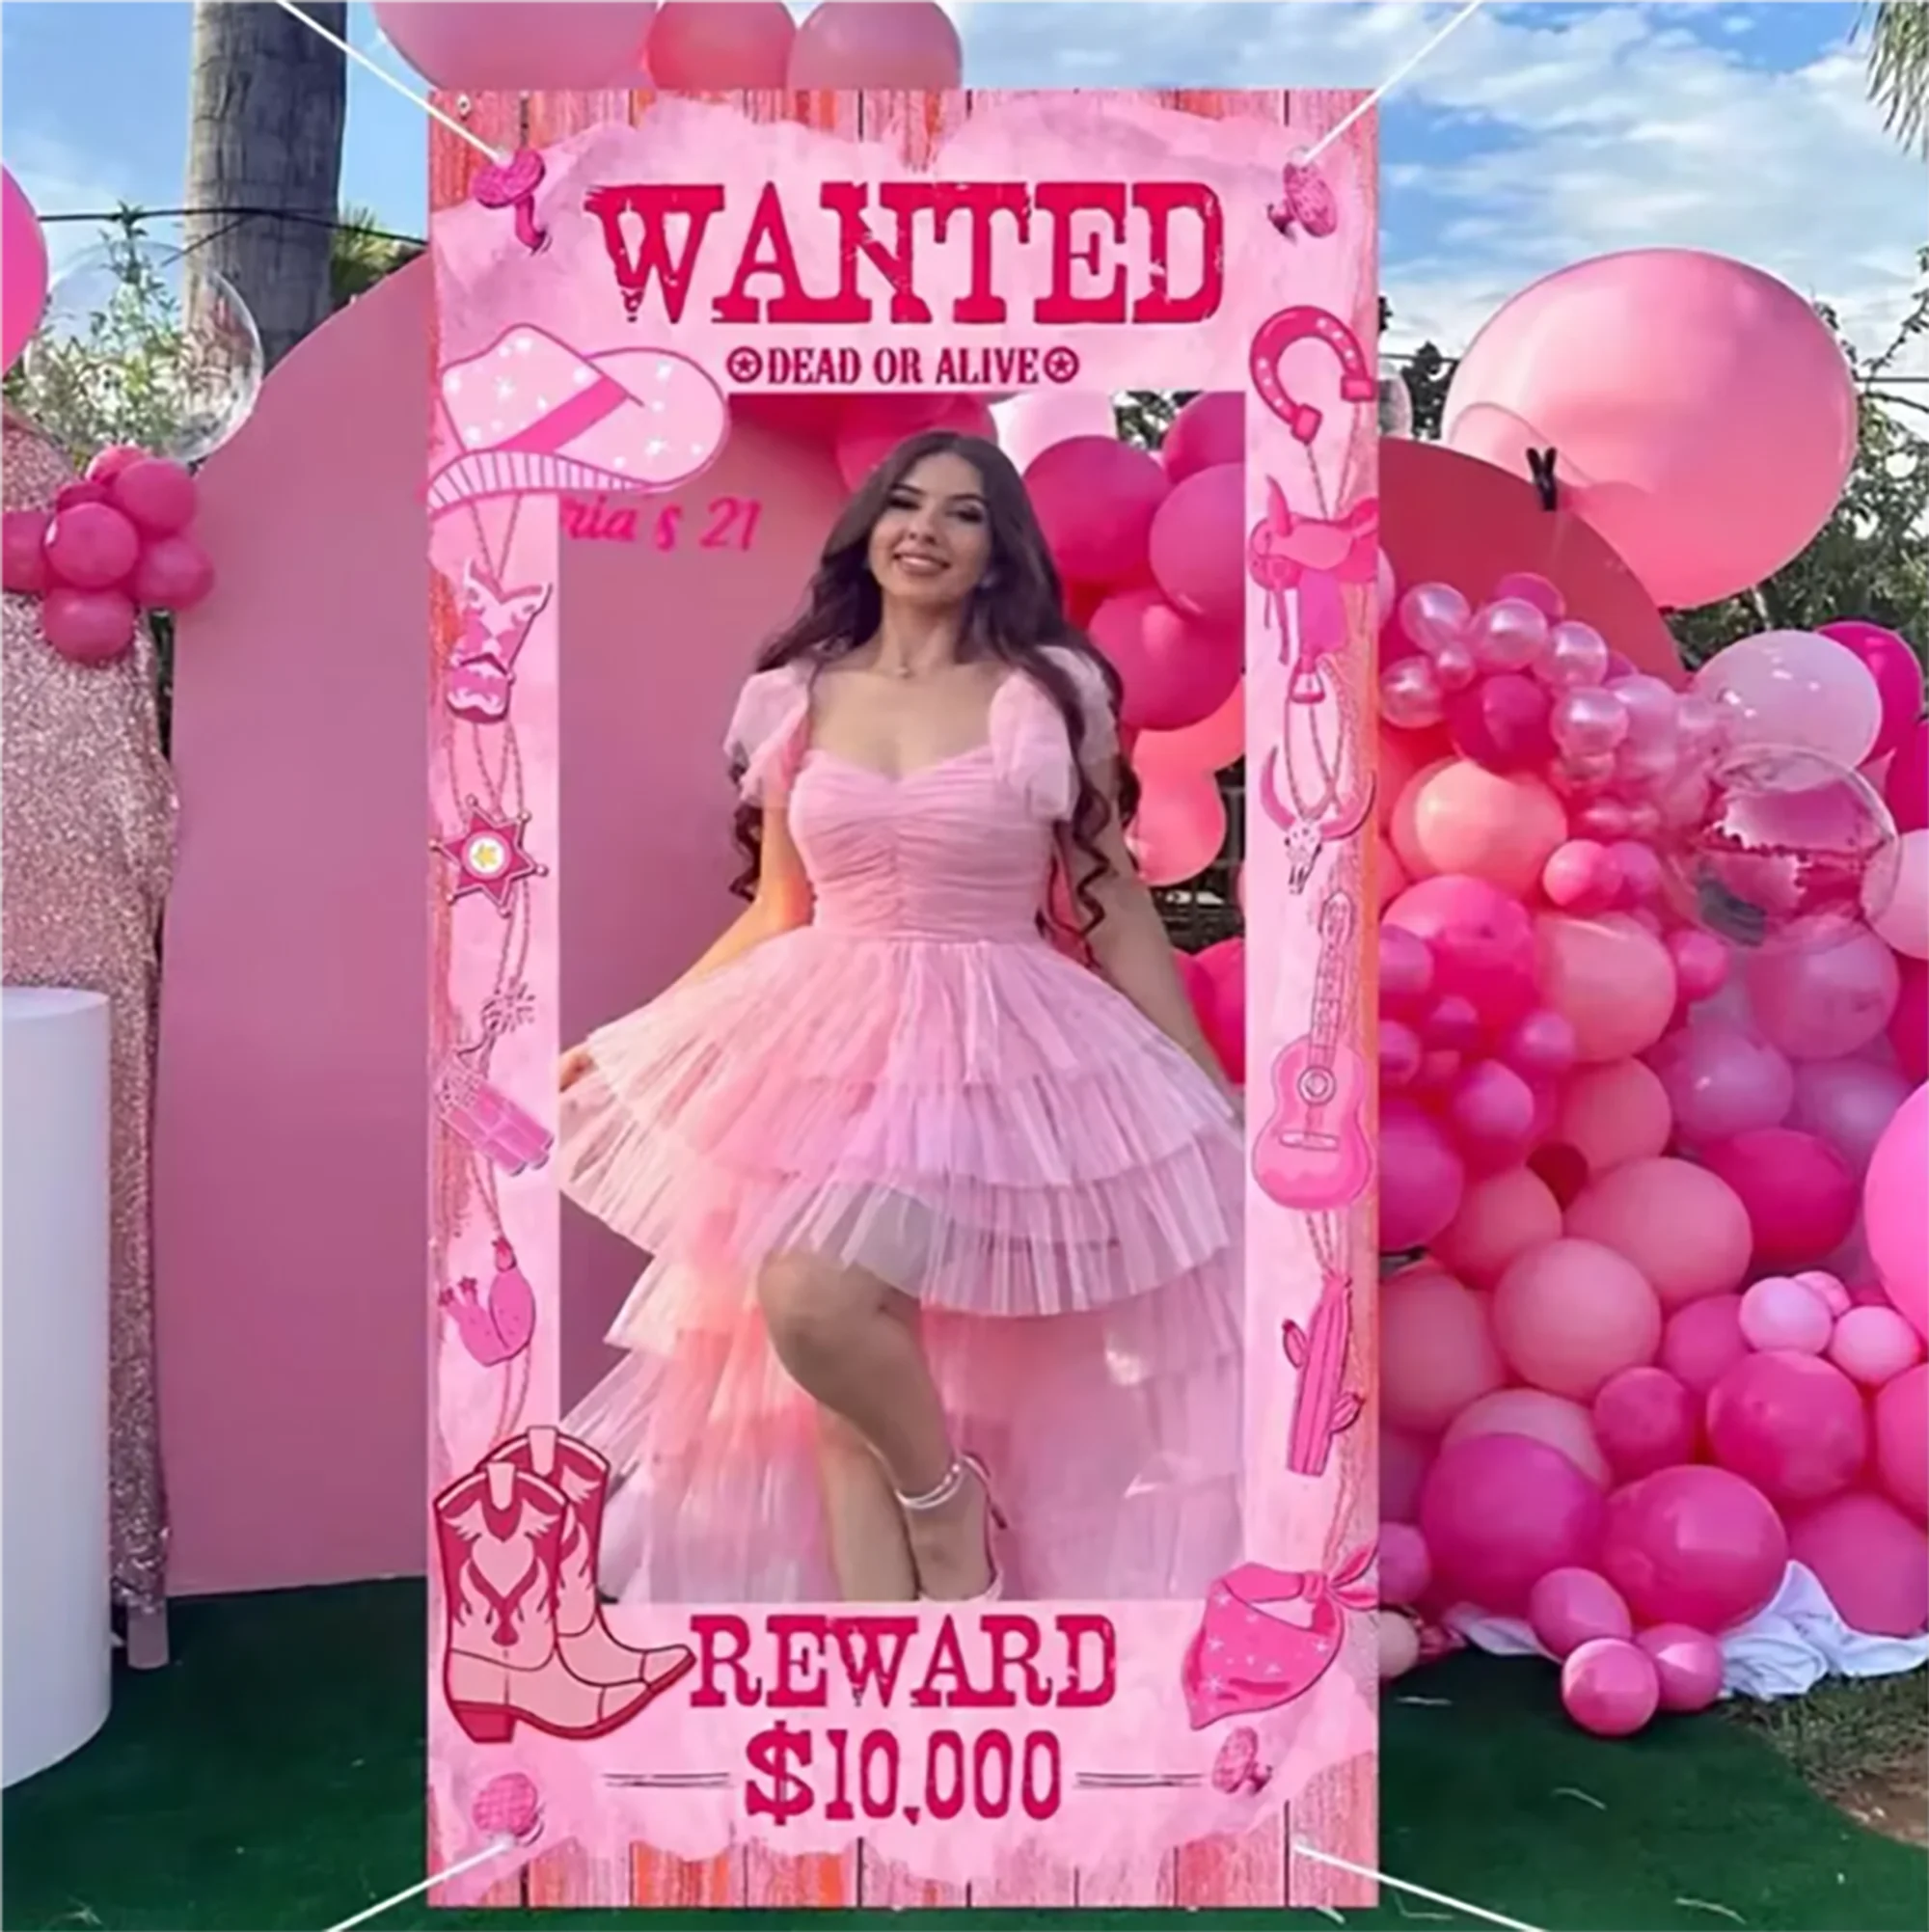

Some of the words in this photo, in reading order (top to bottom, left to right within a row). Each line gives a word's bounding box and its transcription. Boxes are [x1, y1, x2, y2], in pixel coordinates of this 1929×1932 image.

[584, 181, 1224, 324] WANTED
[768, 348, 860, 384] DEAD
[873, 348, 923, 384] OR
[936, 348, 1039, 384] ALIVE
[699, 496, 763, 551] 21
[689, 1614, 1117, 1708] REWARD
[745, 1720, 1063, 1826] $10,000
